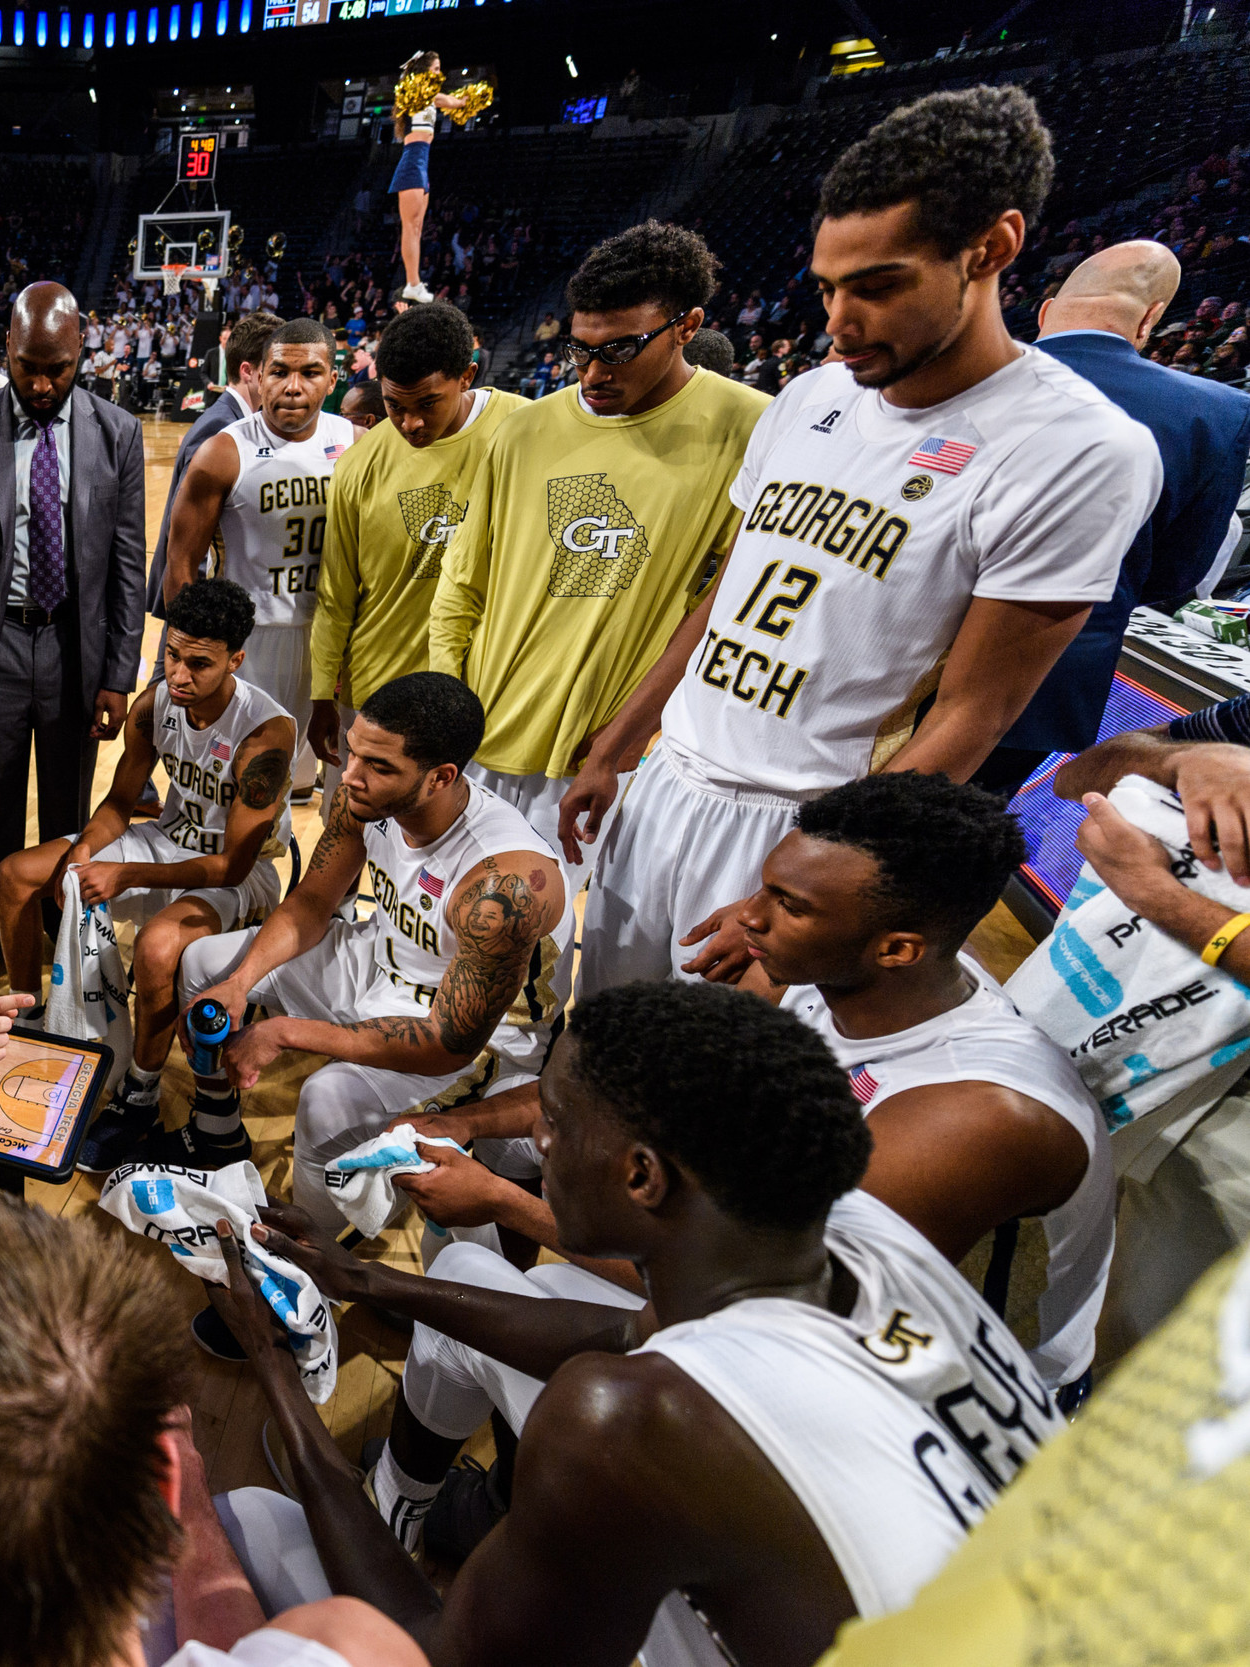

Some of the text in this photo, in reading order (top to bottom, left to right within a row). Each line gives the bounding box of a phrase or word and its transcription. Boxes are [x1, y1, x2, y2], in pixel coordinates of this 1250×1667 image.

[301, 1, 320, 23] 54
[186, 152, 210, 176] 30
[260, 475, 330, 514] GEORG
[282, 515, 327, 559] 30
[562, 515, 635, 558] GT
[745, 481, 912, 581] GEORGIA
[268, 563, 319, 595] TEC
[733, 559, 822, 640] 12
[695, 628, 809, 720] TECH
[162, 752, 240, 808] GEORGIA
[163, 810, 219, 854] TECH
[184, 800, 204, 827] 0
[368, 860, 442, 957] GEORGIA
[53, 1062, 93, 1143] GEORGIA TECH
